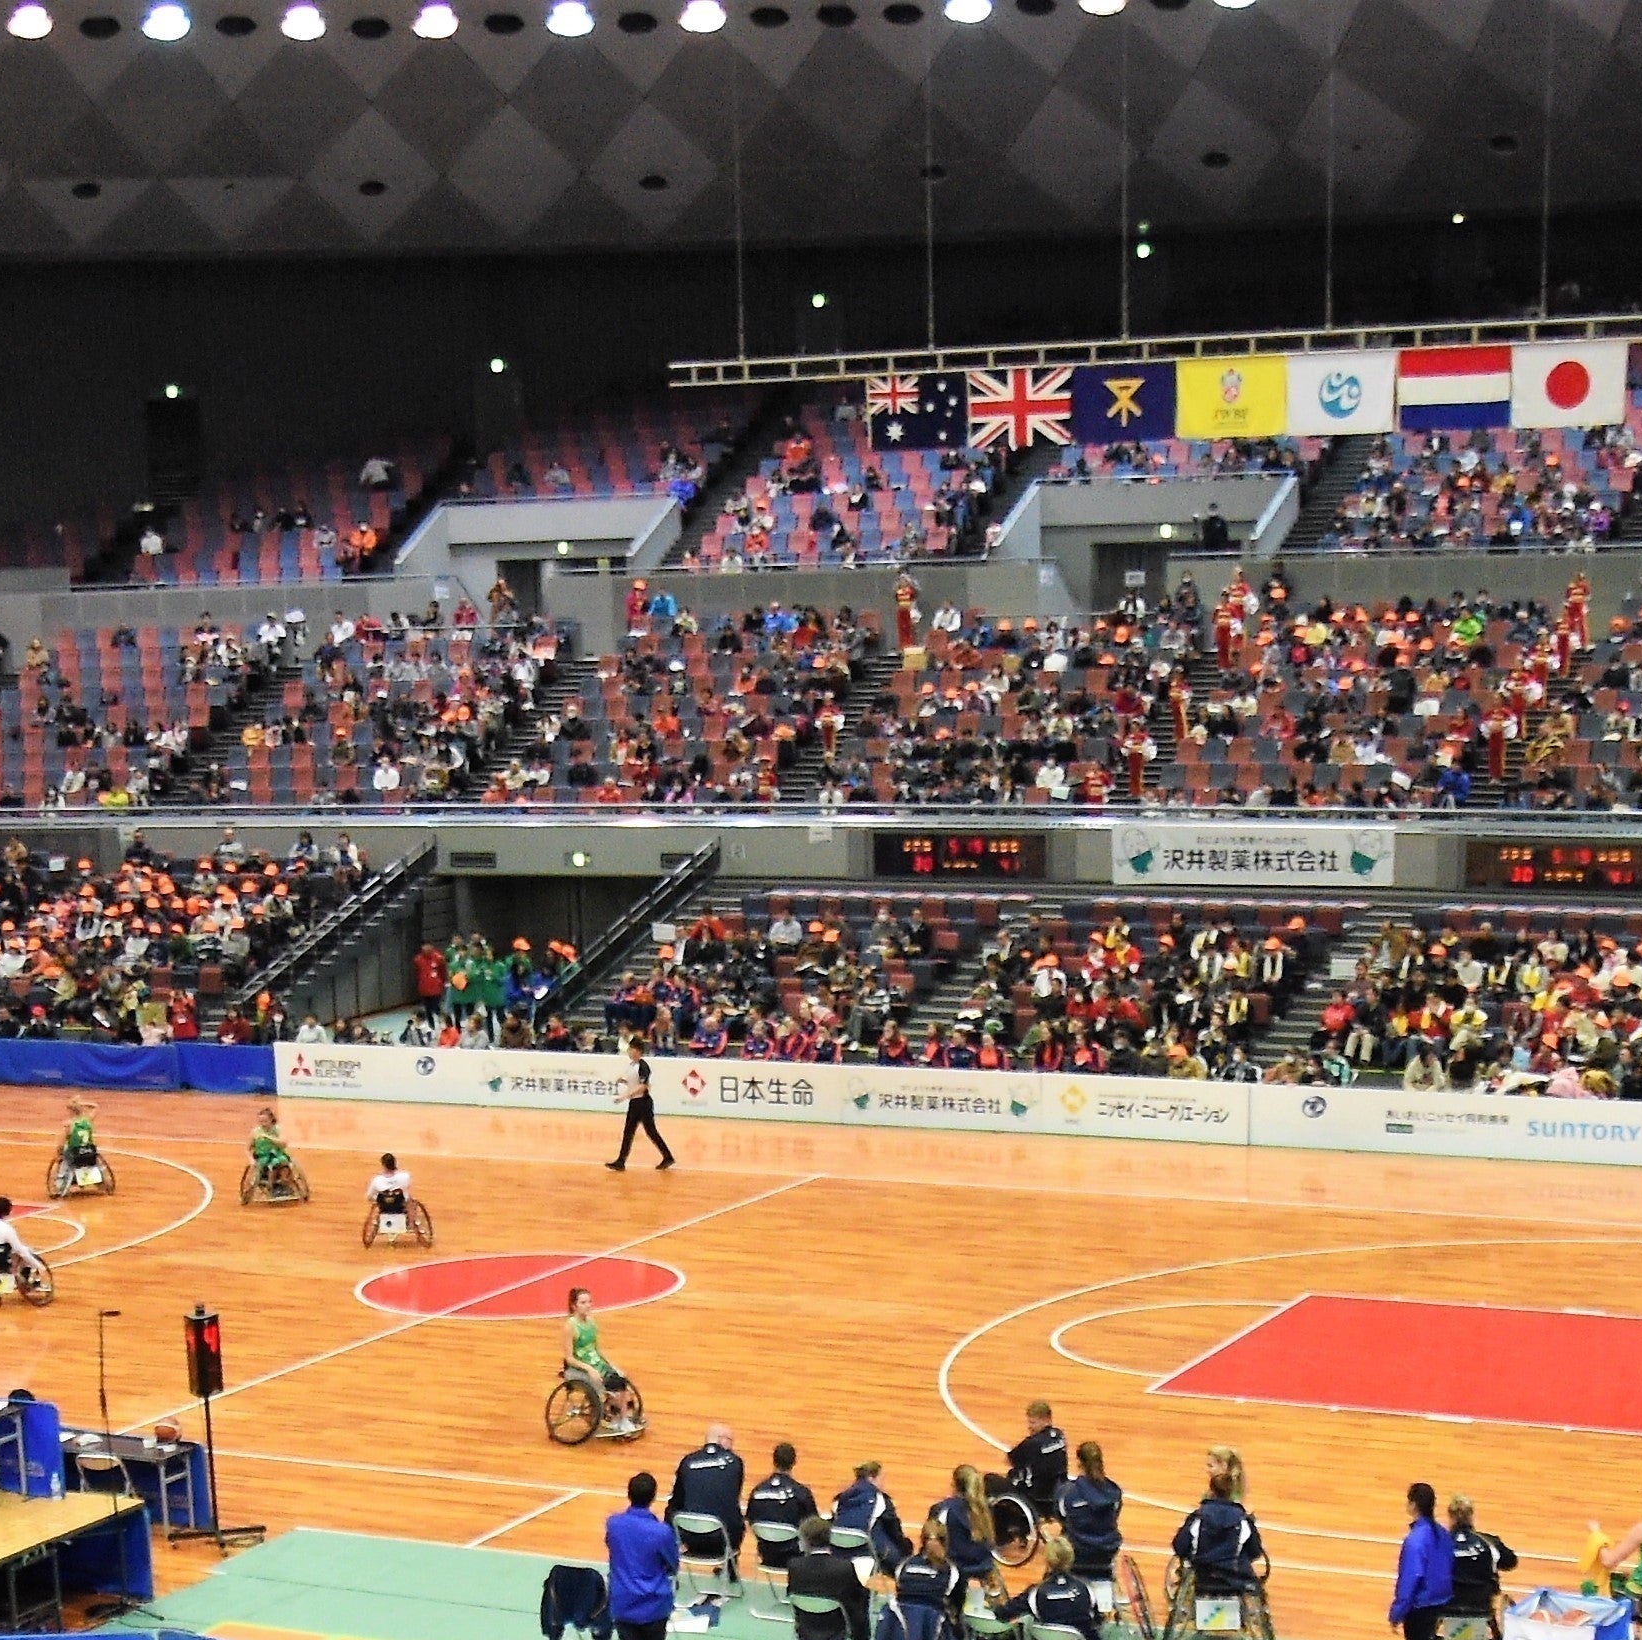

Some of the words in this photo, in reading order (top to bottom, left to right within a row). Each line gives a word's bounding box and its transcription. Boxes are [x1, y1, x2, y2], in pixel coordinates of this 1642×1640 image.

[1163, 849, 1340, 873] 沢井製薬株式会社
[315, 1068, 357, 1079] ELECTRIC
[720, 1076, 814, 1106] 日本生命
[1527, 1120, 1642, 1142] SUNTORY
